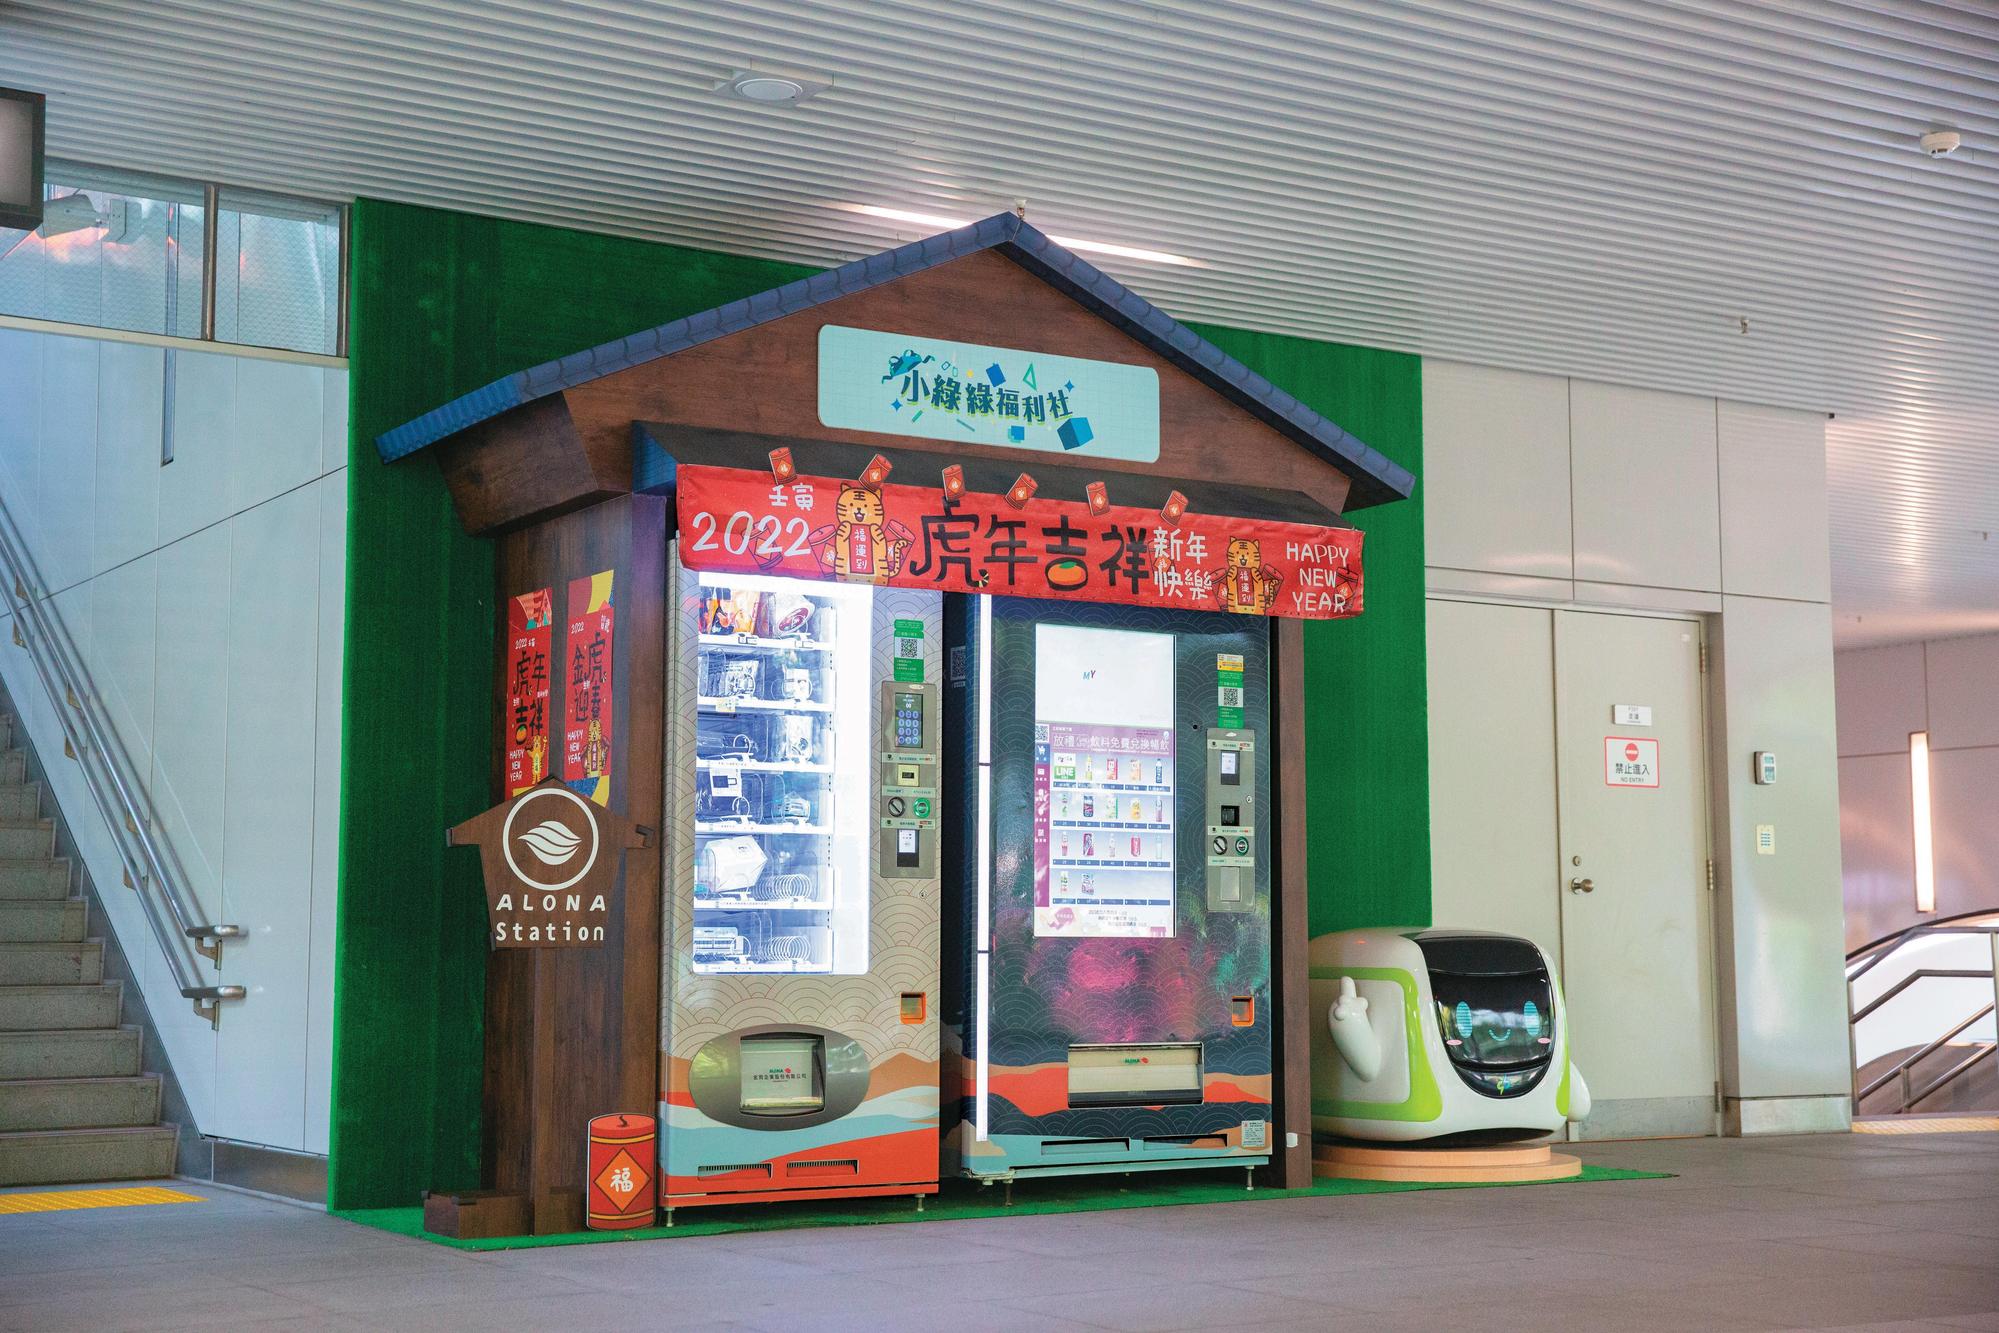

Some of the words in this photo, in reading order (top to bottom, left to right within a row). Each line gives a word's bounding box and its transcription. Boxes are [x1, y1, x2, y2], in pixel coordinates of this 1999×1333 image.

[901, 370, 1073, 424] 小綠綠福利社
[768, 483, 814, 511] 壬寅
[692, 511, 811, 557] 2022
[909, 496, 1149, 594] 虎年吉祥
[1153, 526, 1209, 564] 新年
[854, 529, 867, 569] 福運到
[1286, 541, 1349, 567] HAPPY
[1153, 565, 1212, 600] 快樂
[1300, 568, 1337, 588] NEW
[1292, 591, 1346, 613] YEAR
[1082, 670, 1096, 680] MY
[567, 729, 584, 740] HAPPY
[509, 749, 525, 759] HAPPY
[1615, 763, 1650, 775] 禁止進入
[495, 893, 606, 912] ALONA
[496, 921, 604, 941] Station
[610, 1167, 634, 1192] 福
